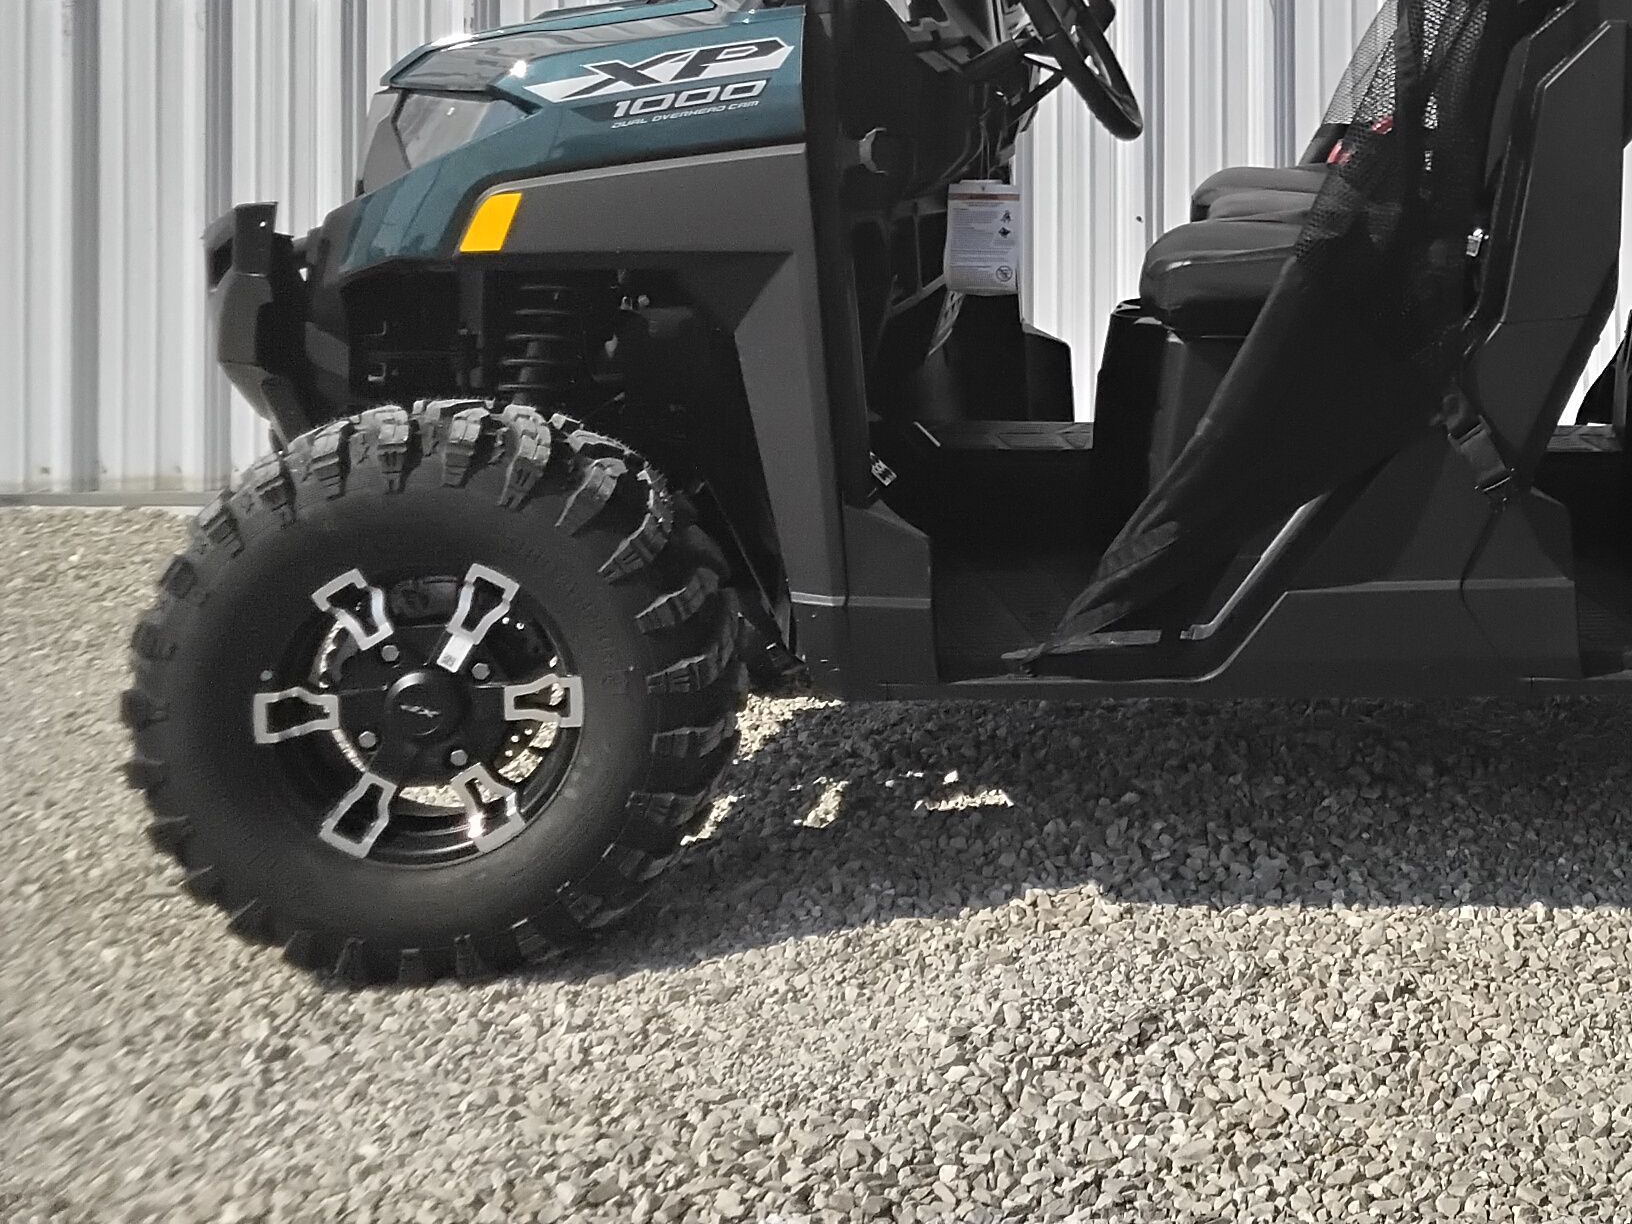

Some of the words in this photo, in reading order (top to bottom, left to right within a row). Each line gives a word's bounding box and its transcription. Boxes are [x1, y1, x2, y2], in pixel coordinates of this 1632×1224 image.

[560, 37, 787, 100] XP
[611, 118, 648, 129] DUAL
[652, 105, 726, 122] OVERHEAD
[728, 100, 760, 110] CAM
[613, 79, 767, 118] 1000
